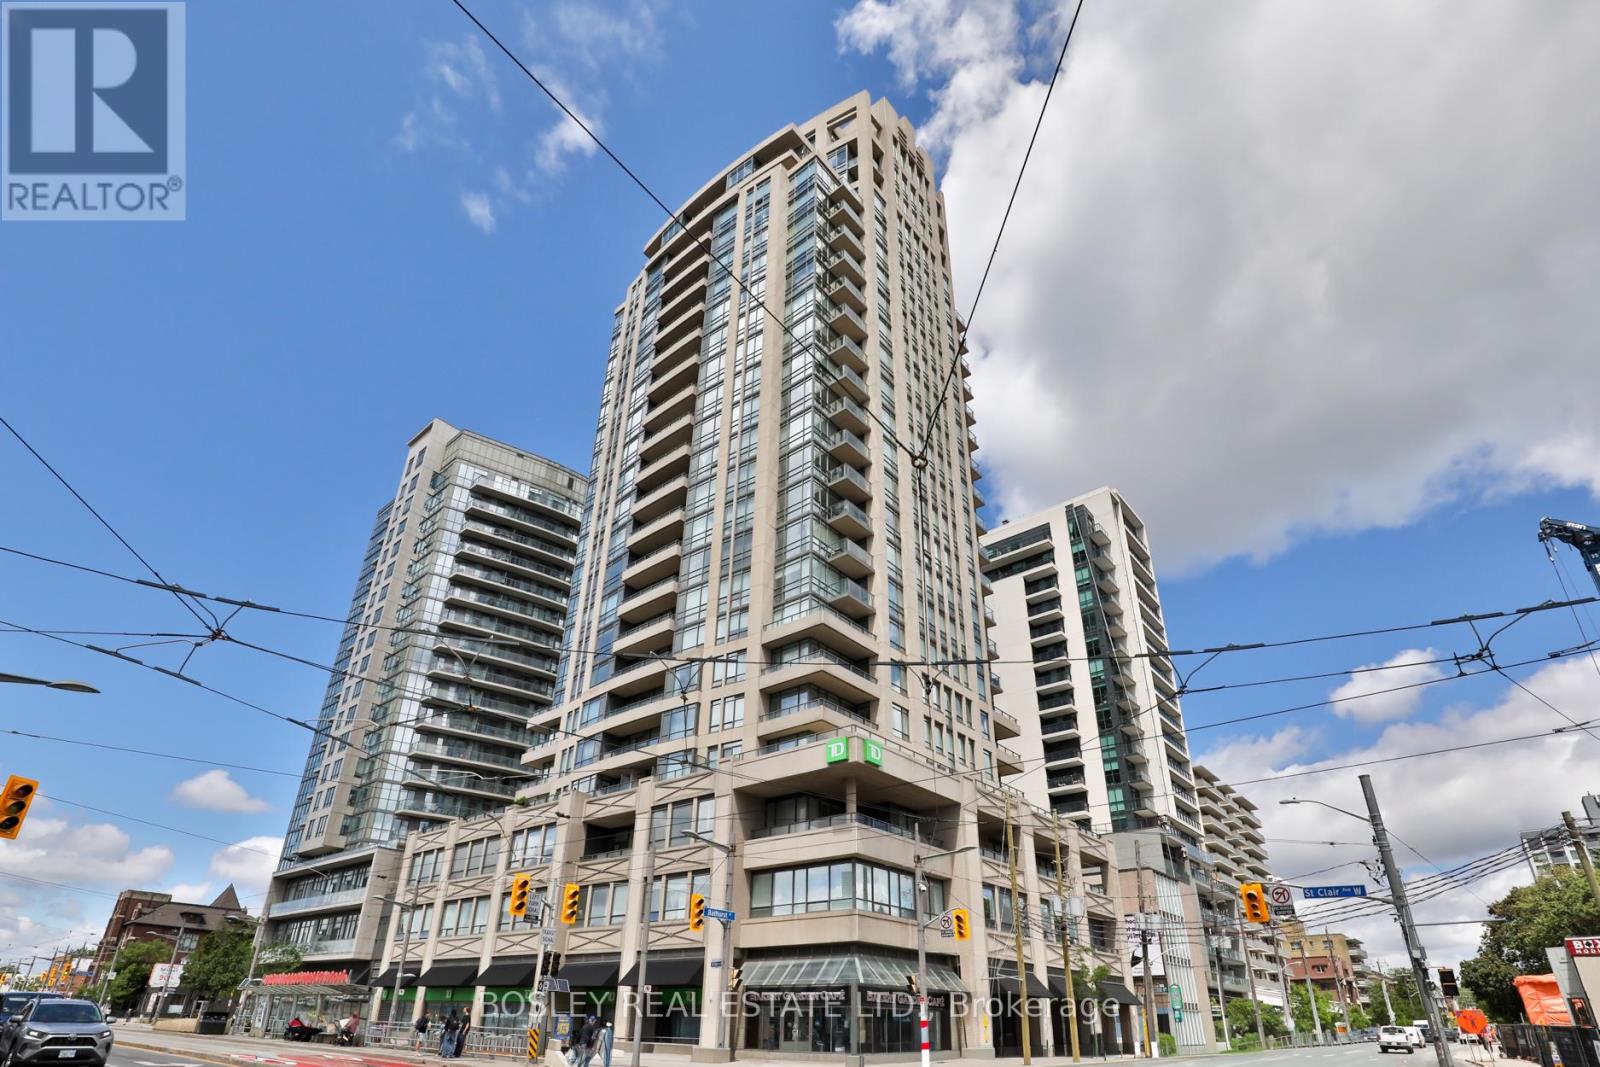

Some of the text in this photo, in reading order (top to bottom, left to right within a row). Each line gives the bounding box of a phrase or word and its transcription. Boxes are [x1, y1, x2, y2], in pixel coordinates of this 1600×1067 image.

[828, 742, 845, 758] TD
[868, 743, 881, 760] TD
[1304, 888, 1314, 897] St
[1317, 887, 1340, 897] Clair
[1353, 886, 1362, 896] W
